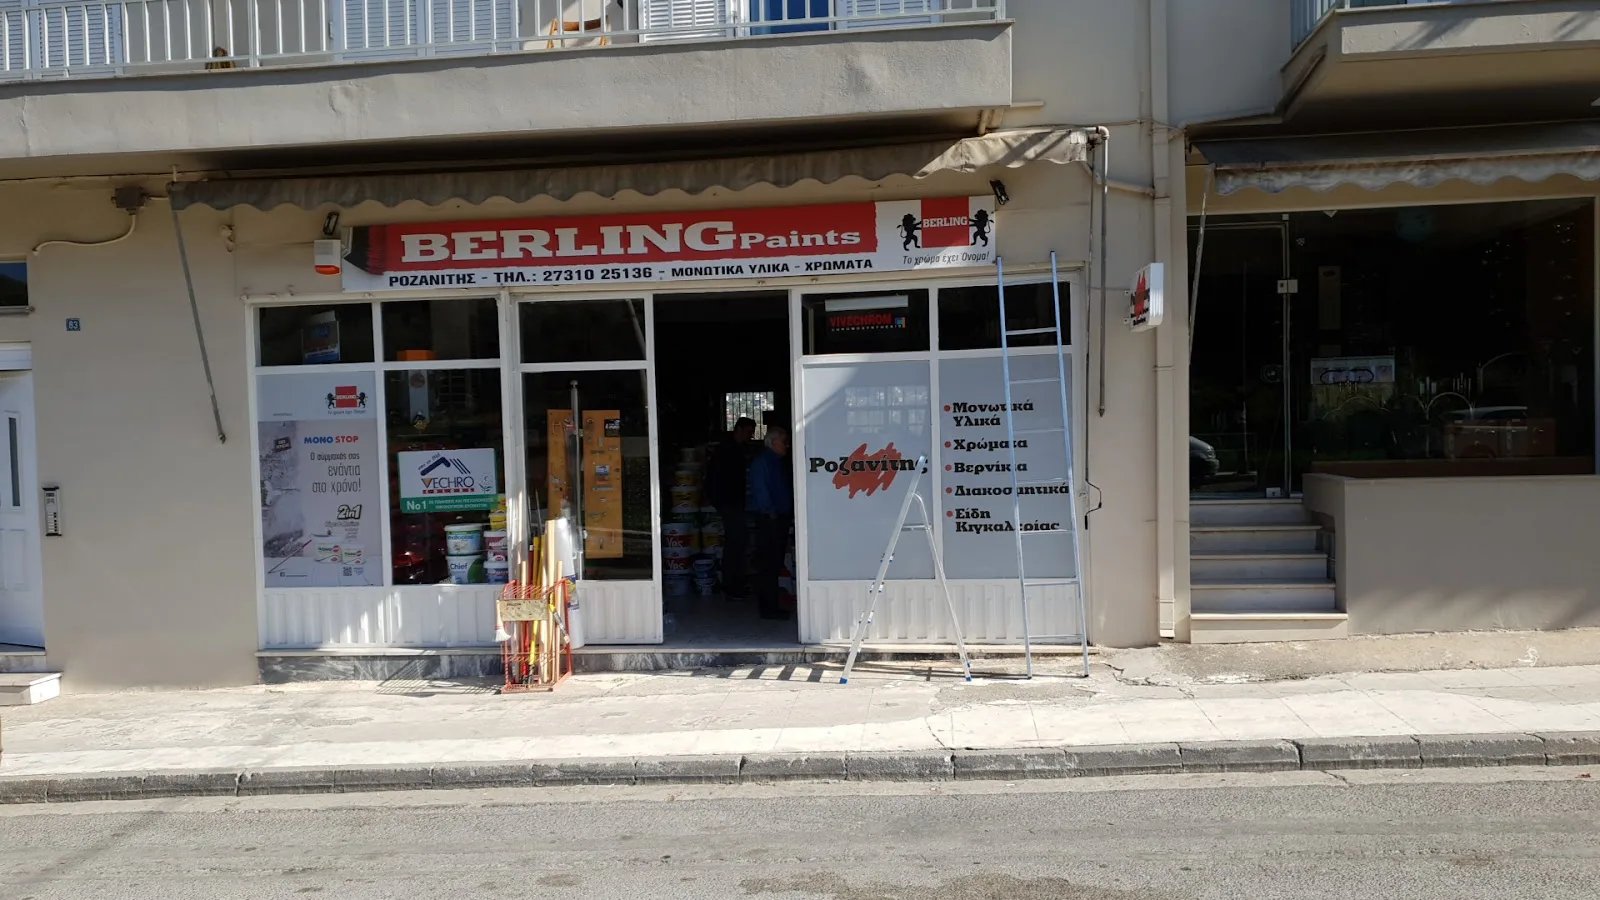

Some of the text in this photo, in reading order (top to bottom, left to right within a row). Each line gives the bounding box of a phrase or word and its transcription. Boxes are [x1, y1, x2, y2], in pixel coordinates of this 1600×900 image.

[923, 216, 968, 228] BERLING
[401, 221, 860, 263] BERLING Paints
[388, 273, 476, 287] ΡΟΖΑΝΙΤΗΣ
[543, 269, 595, 282] 27310
[600, 267, 653, 280] 25136
[671, 265, 744, 277] ΜΟΝΩΤΙΚΑ
[749, 263, 790, 274] ΥΛΙΚΑ
[805, 259, 873, 271] ΧΡΩΜΑΤΑ
[952, 399, 1034, 414] Μονωτκά
[953, 414, 1001, 427] Υλικά
[304, 435, 359, 444] MONO STOP
[328, 462, 361, 477] ενάντια
[954, 461, 1028, 475] Βερνίκα
[312, 481, 327, 493] στο
[421, 475, 475, 489] VECHRO
[955, 508, 991, 519] Είδη
